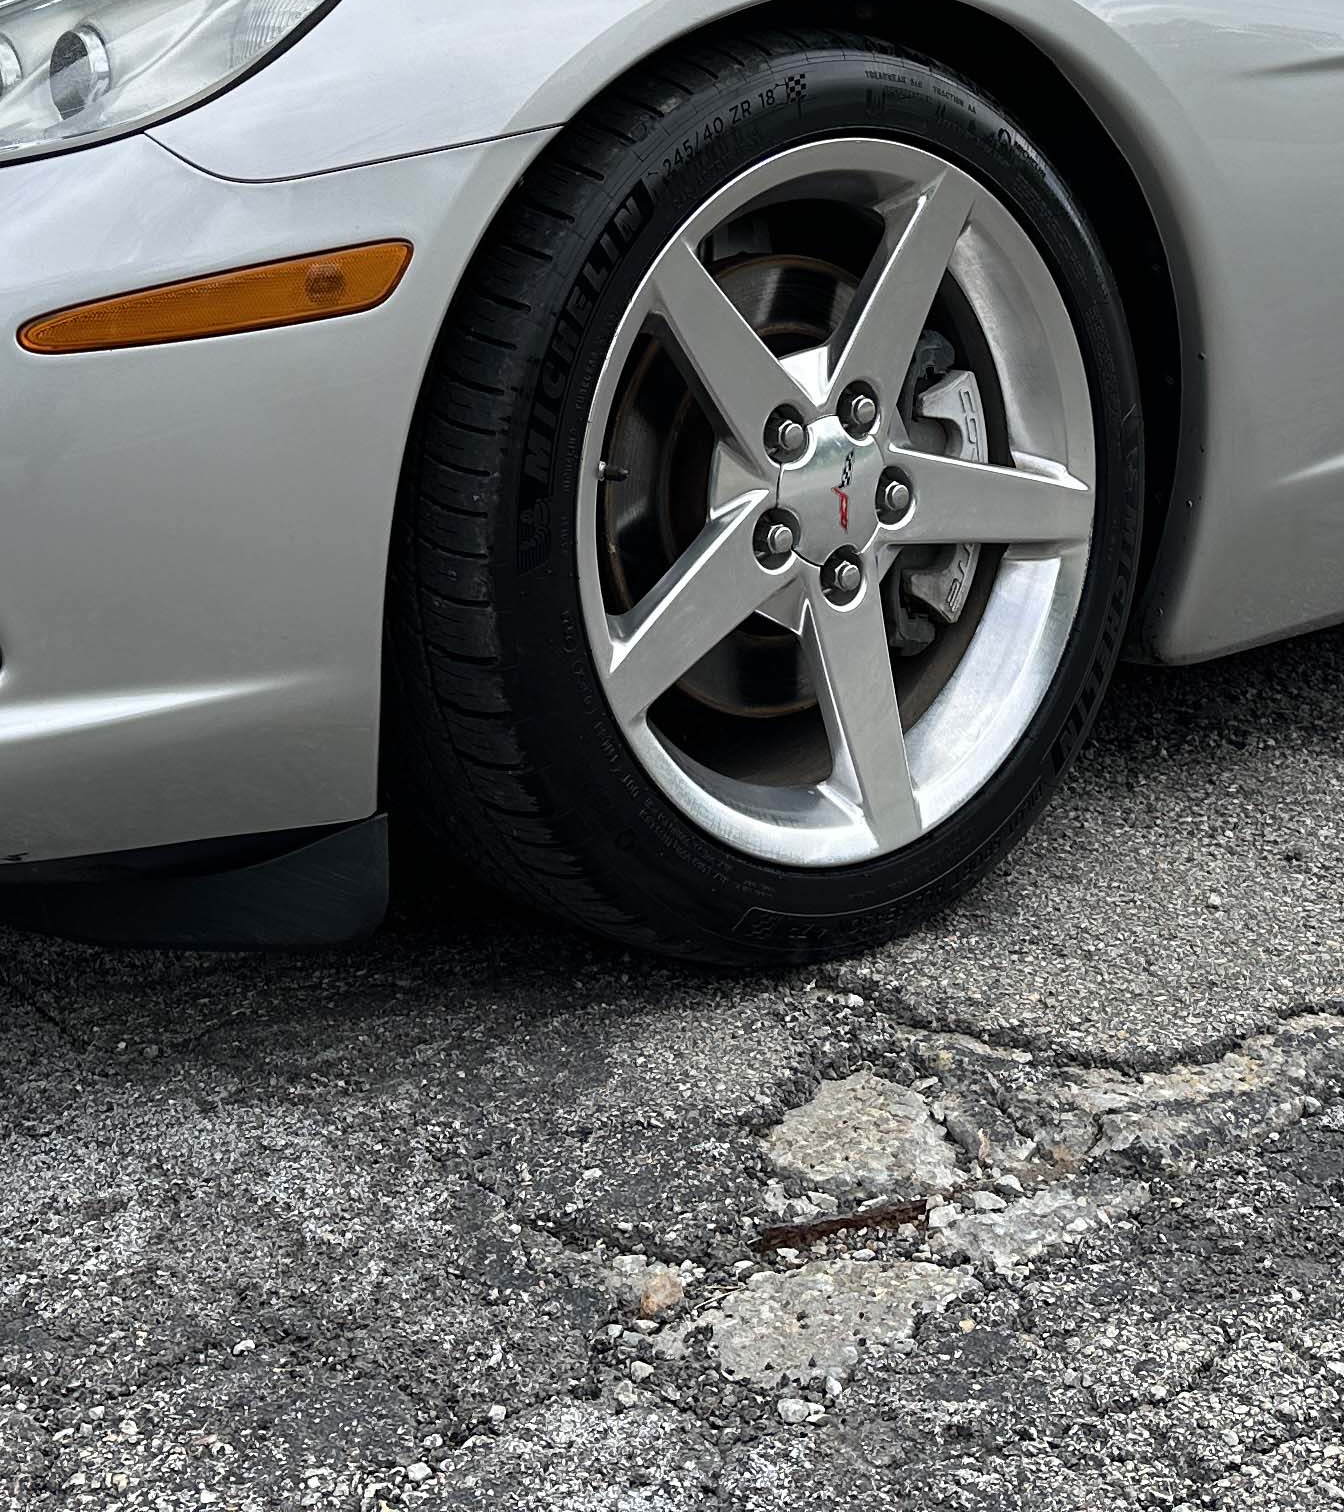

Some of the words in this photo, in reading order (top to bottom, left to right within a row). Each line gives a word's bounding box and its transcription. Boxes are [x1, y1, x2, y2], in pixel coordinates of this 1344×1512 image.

[662, 116, 724, 177] 245/40
[728, 99, 752, 125] ZR
[758, 89, 775, 109] 18
[523, 195, 643, 483] MICHELIN
